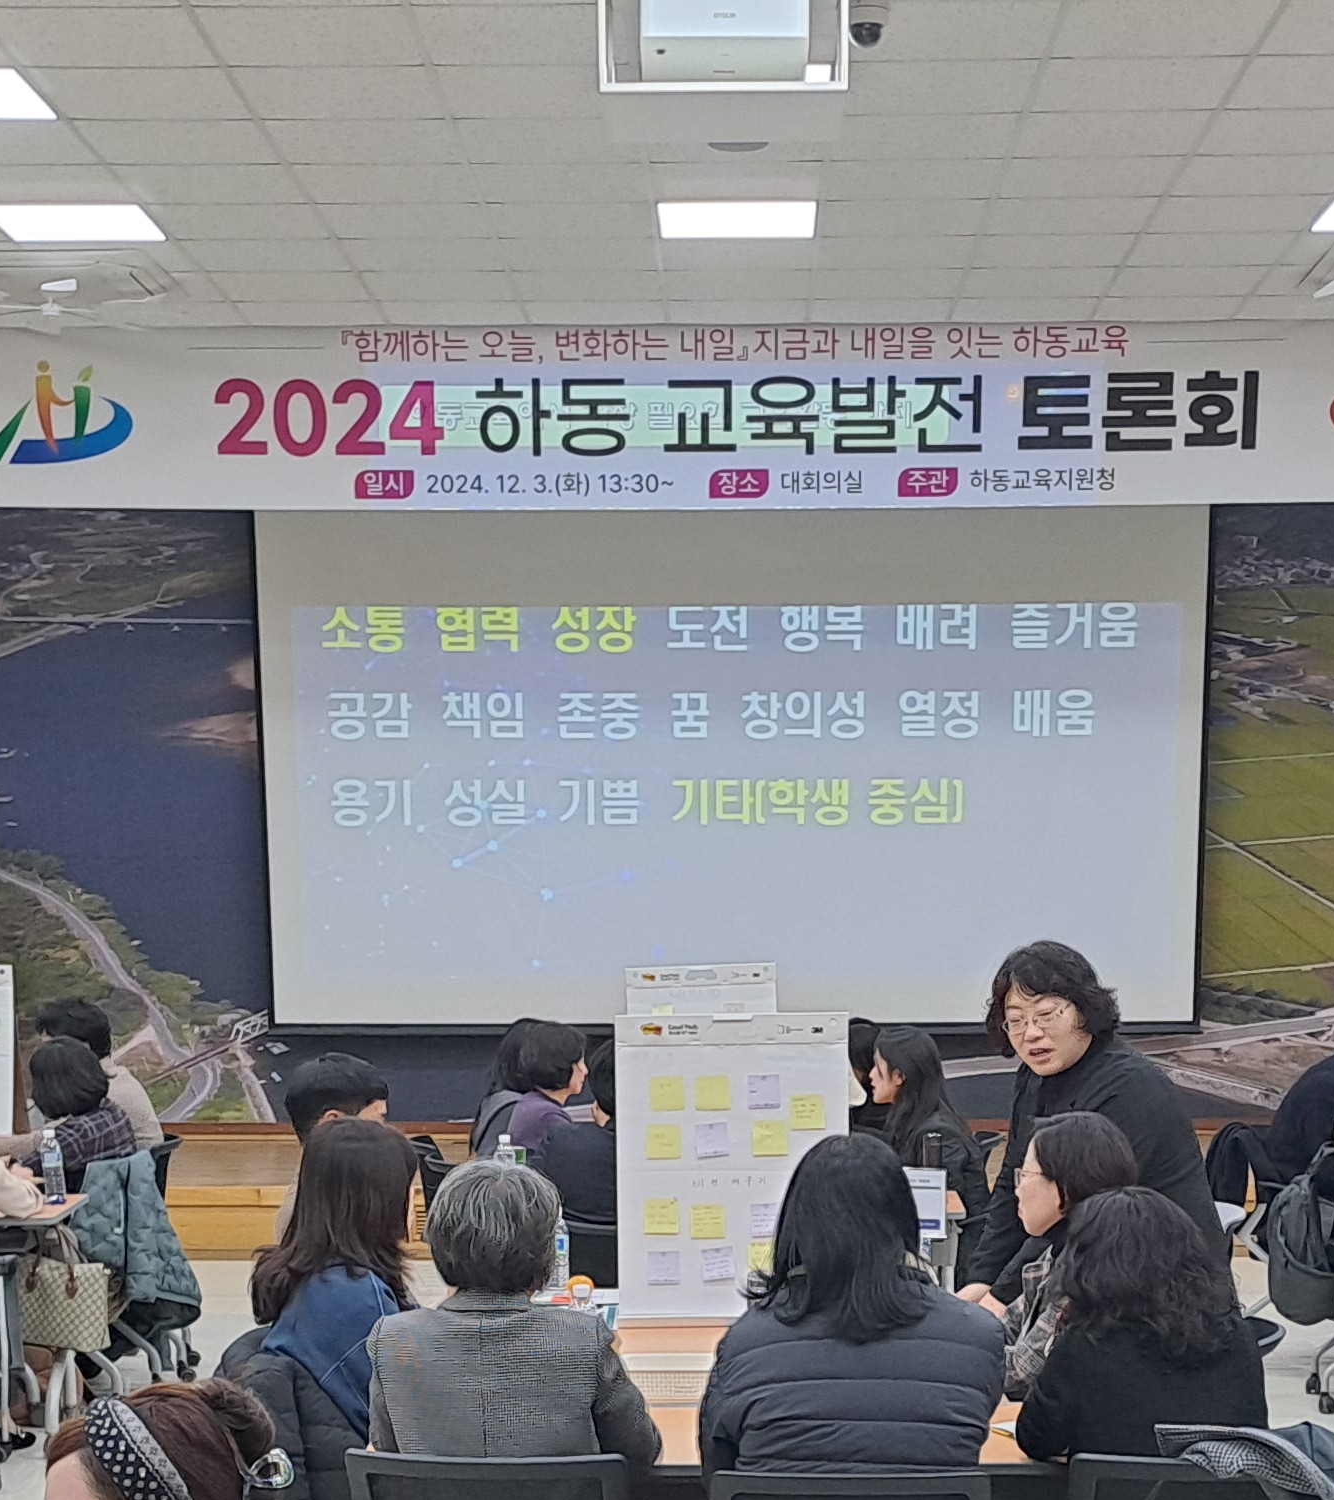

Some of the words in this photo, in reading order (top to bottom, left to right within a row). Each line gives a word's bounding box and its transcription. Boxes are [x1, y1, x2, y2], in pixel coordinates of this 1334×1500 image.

[479, 330, 544, 364] 오늘,
[554, 329, 669, 362] 변화하는
[850, 326, 936, 360] 내일을
[946, 326, 1003, 359] 잇는
[1012, 325, 1130, 358] 하동교육
[214, 377, 445, 457] 2024
[475, 376, 632, 457] 하동
[663, 374, 983, 456] 교육발전
[1017, 369, 1260, 452] 토론회
[362, 471, 405, 496] 일시
[426, 474, 489, 494] 2024.
[496, 474, 527, 494] 12.
[533, 473, 590, 497] 3.(화)
[598, 473, 675, 494] 13:30~
[717, 471, 760, 495] 장소
[780, 470, 864, 495] 대회의실
[906, 469, 950, 493] 주관
[969, 467, 1117, 492] 하동교육지원청
[321, 604, 406, 653] 소통
[435, 604, 521, 653] 협력
[552, 604, 637, 653] 성장
[667, 604, 750, 652] 도전
[781, 603, 865, 652] 행복
[896, 602, 979, 651] 배려
[1011, 602, 1139, 650] 즐거움
[328, 692, 412, 741] 공감
[442, 691, 526, 740] 책임
[557, 691, 640, 739] 존중
[671, 691, 711, 739] 꿈
[740, 689, 866, 738] 창의성
[898, 689, 981, 738] 열정
[1011, 687, 1095, 737] 배움
[331, 779, 414, 828] 용기
[444, 779, 527, 827] 성실
[558, 779, 641, 827] 기쁨
[671, 777, 850, 827] 기타(학생
[867, 777, 966, 826] 중심)
